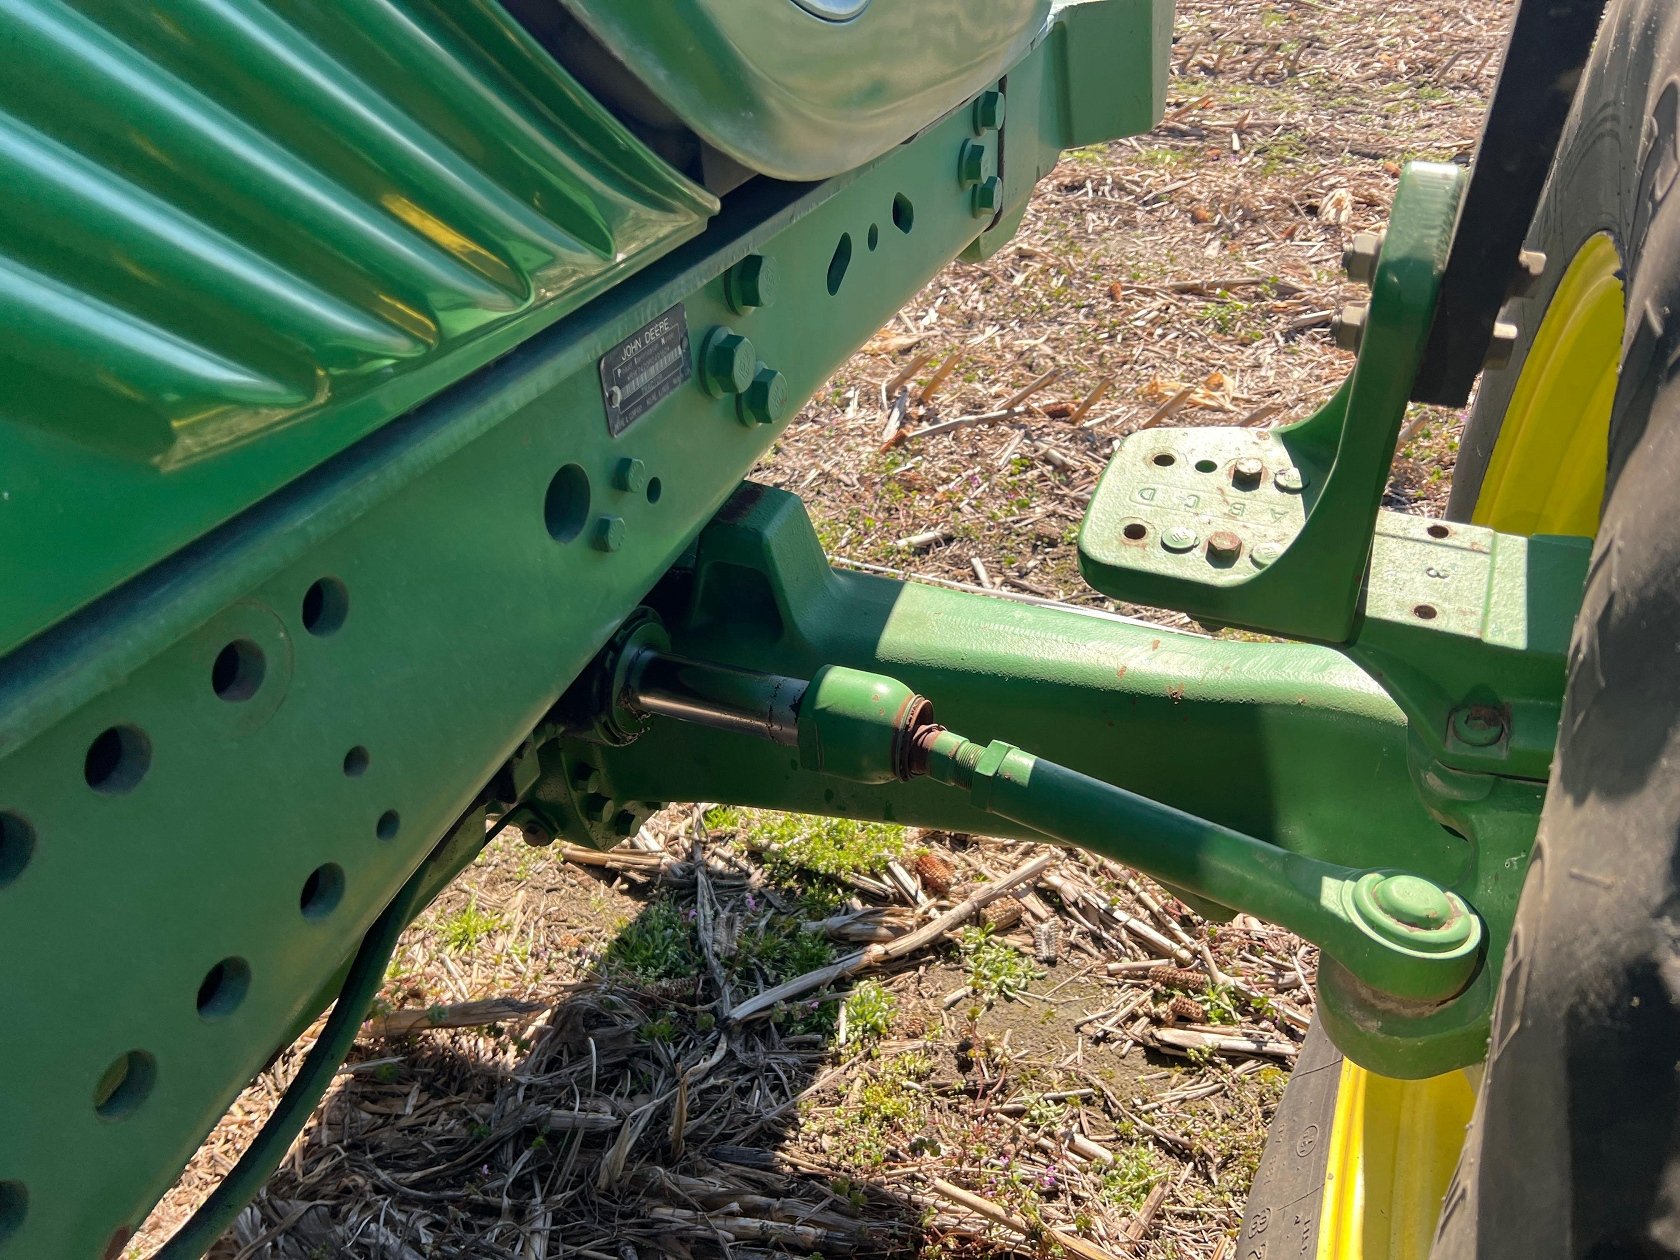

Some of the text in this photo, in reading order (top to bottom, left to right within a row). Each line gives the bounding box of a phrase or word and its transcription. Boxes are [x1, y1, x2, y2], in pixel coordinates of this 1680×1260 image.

[622, 338, 642, 361] JOHN
[645, 317, 669, 344] DEERE
[1138, 488, 1156, 501] D
[1184, 494, 1200, 509] C
[1229, 502, 1246, 517] B
